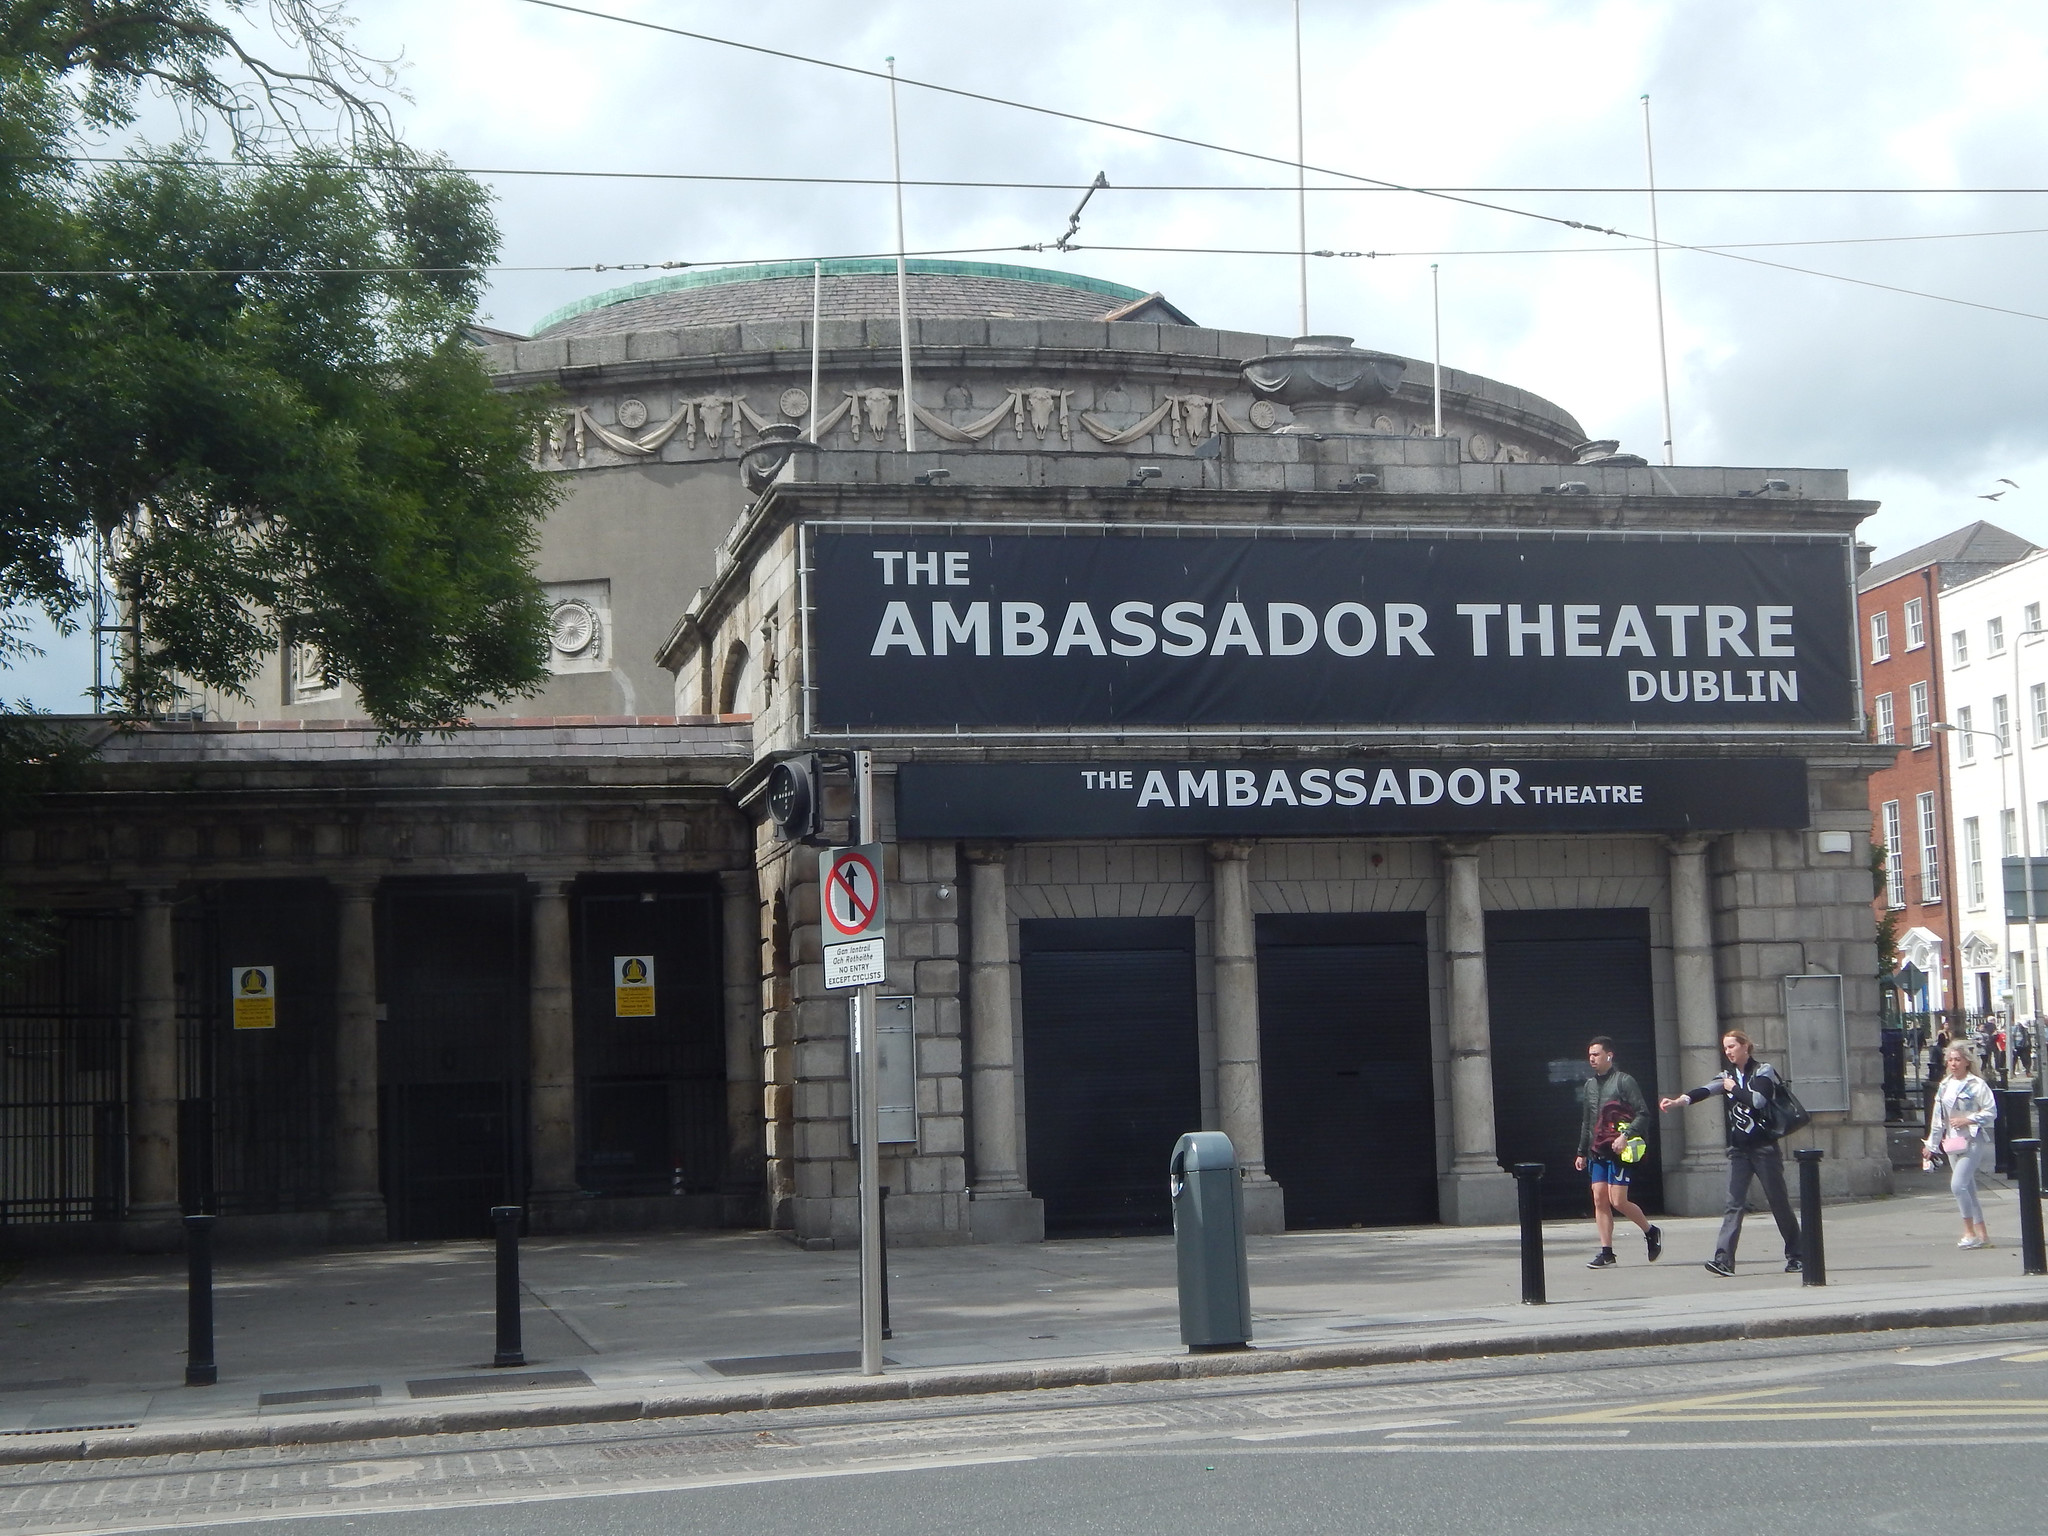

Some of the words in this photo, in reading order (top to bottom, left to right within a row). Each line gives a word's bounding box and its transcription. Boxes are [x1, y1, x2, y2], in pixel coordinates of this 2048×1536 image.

[872, 550, 971, 586] THE
[869, 600, 1437, 657] AMBASSADOR
[1456, 603, 1796, 657] THEATRE
[1627, 670, 1799, 703] DUBLIN
[1081, 770, 1135, 790] THE
[1136, 767, 1526, 808] AMBASSADOR
[1529, 785, 1644, 804] THEATRE
[828, 975, 851, 985] EXCEPT
[852, 971, 881, 982] CYCLISTS
[850, 963, 869, 972] ENTRY
